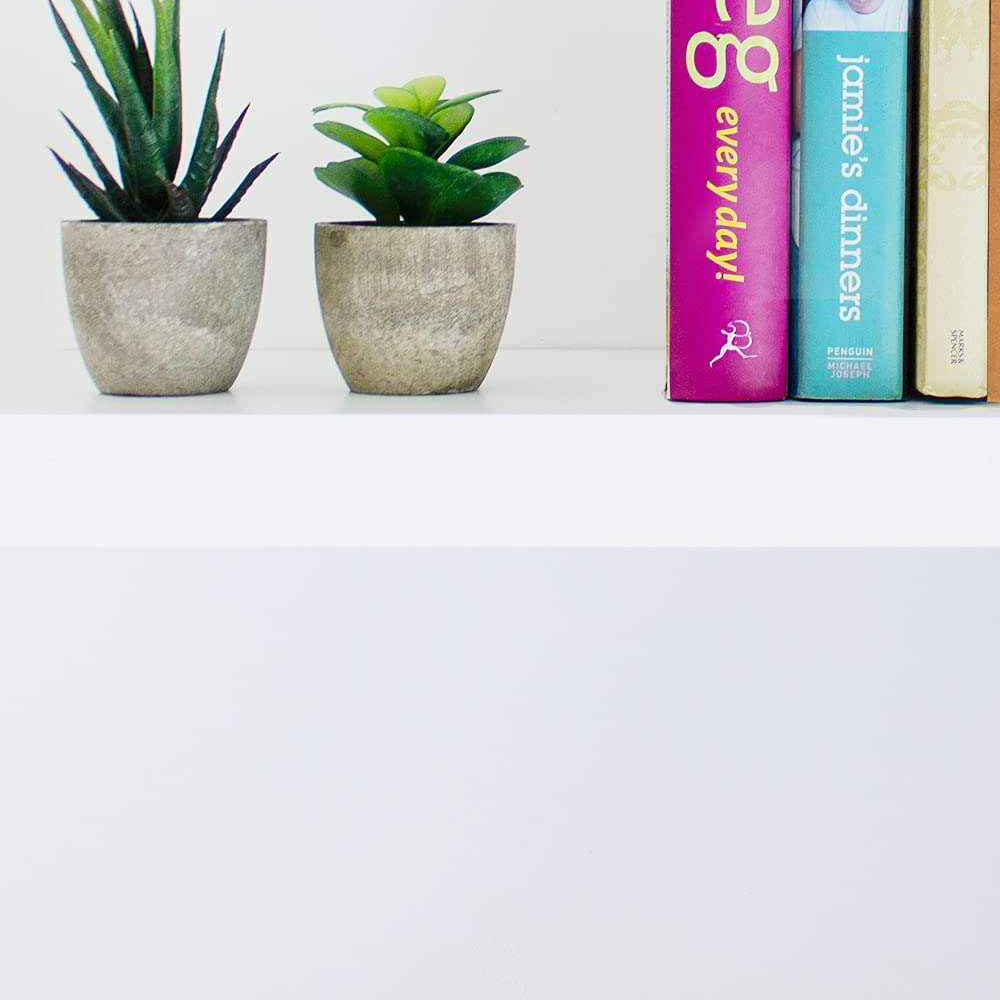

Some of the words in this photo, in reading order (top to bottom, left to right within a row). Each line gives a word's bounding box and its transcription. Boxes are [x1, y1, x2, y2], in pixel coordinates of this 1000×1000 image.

[836, 55, 869, 178] jamie's
[840, 188, 867, 322] dinners
[827, 346, 873, 356] PENGUIN
[826, 361, 872, 371] MICHAEL
[830, 370, 870, 379] JOSEPH
